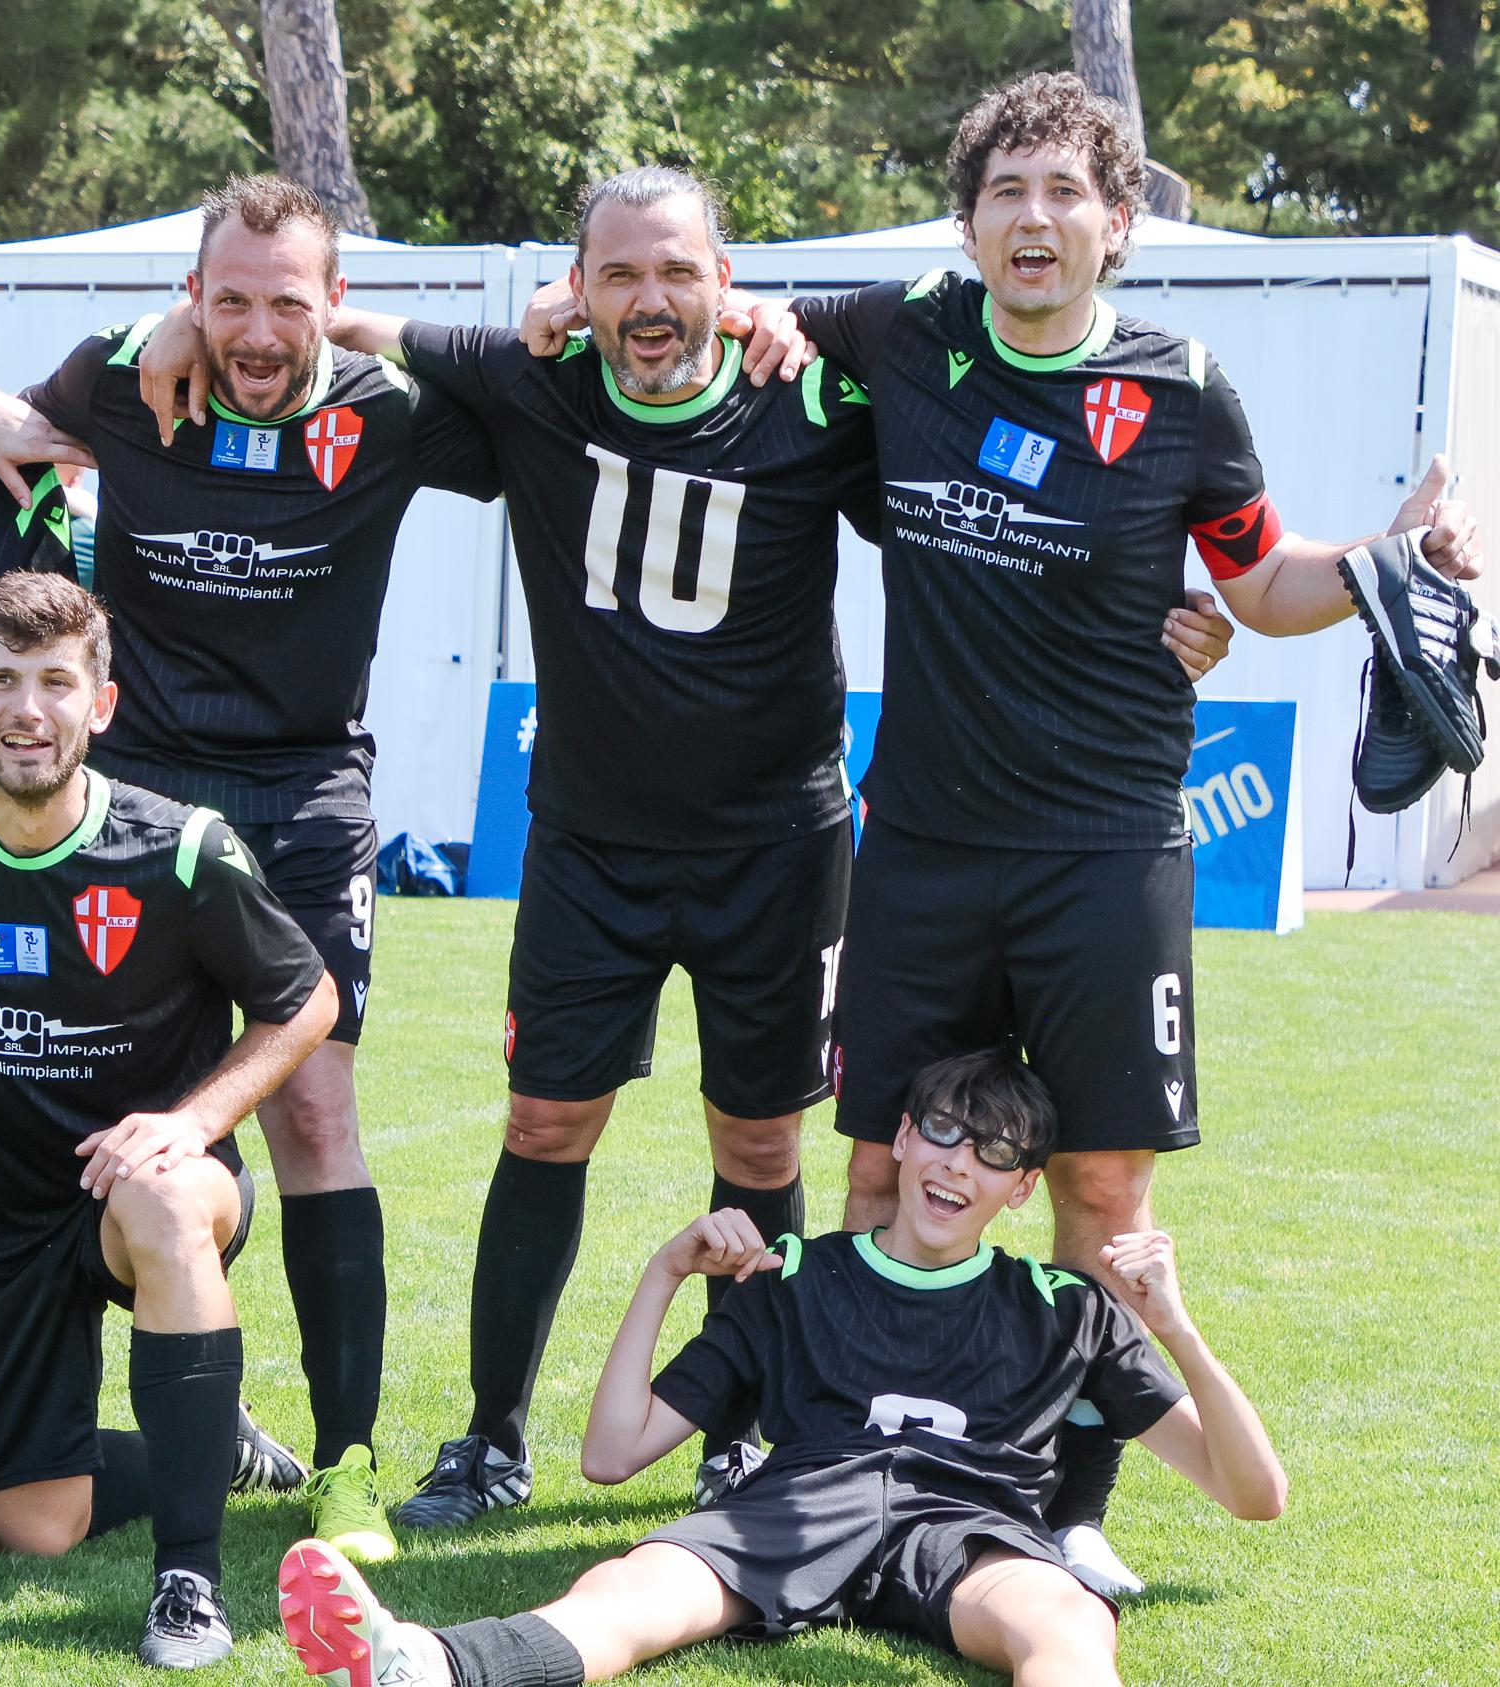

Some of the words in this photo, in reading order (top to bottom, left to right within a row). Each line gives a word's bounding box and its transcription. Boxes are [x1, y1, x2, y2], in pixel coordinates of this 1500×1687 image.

[1117, 409, 1142, 421] A.C.P.
[334, 436, 357, 445] A.C.P.
[584, 442, 747, 634] 10
[886, 495, 933, 520] NALIN
[959, 519, 980, 533] SRL
[1001, 528, 1091, 562] IMPIANTI
[135, 545, 186, 566] NALIN
[212, 563, 232, 573] SRL
[254, 565, 333, 578] IMPIANTI
[896, 526, 1044, 576] www.nalinimpianti.it
[148, 570, 294, 600] www.nalinimpianti.it
[108, 918, 134, 926] A.C.P.
[349, 874, 373, 951] 9
[1152, 972, 1182, 1055] 6
[4, 1042, 25, 1052] SRL
[48, 1042, 133, 1057] IMPIANTI
